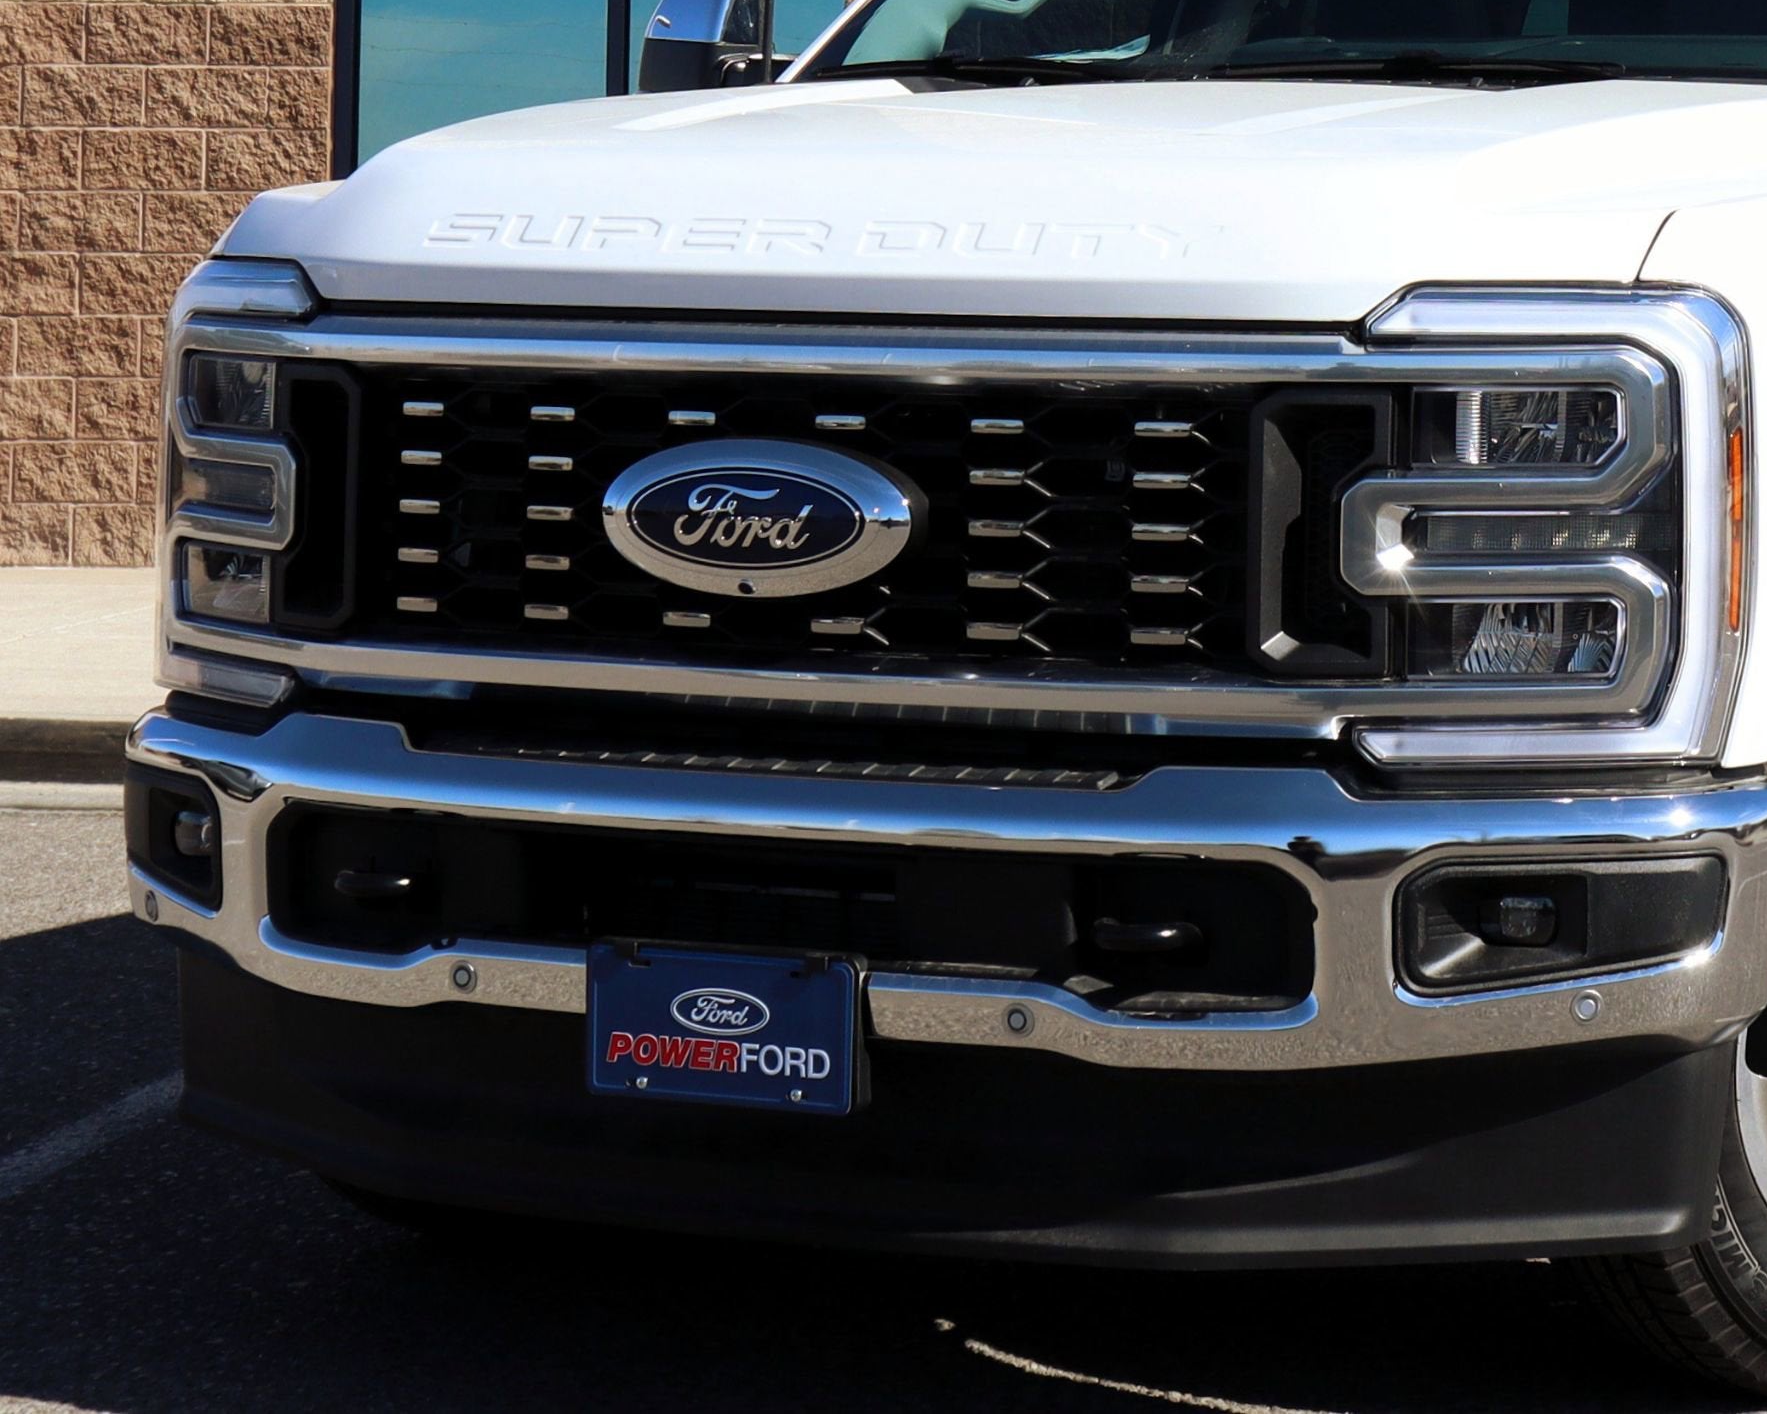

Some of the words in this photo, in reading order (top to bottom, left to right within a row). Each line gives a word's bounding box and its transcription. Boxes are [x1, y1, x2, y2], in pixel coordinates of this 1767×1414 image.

[422, 213, 833, 254] SUPER
[855, 218, 1226, 260] DUTY
[672, 483, 814, 551] Ford
[690, 995, 750, 1027] Ford
[606, 1031, 831, 1080] POWERFORD
